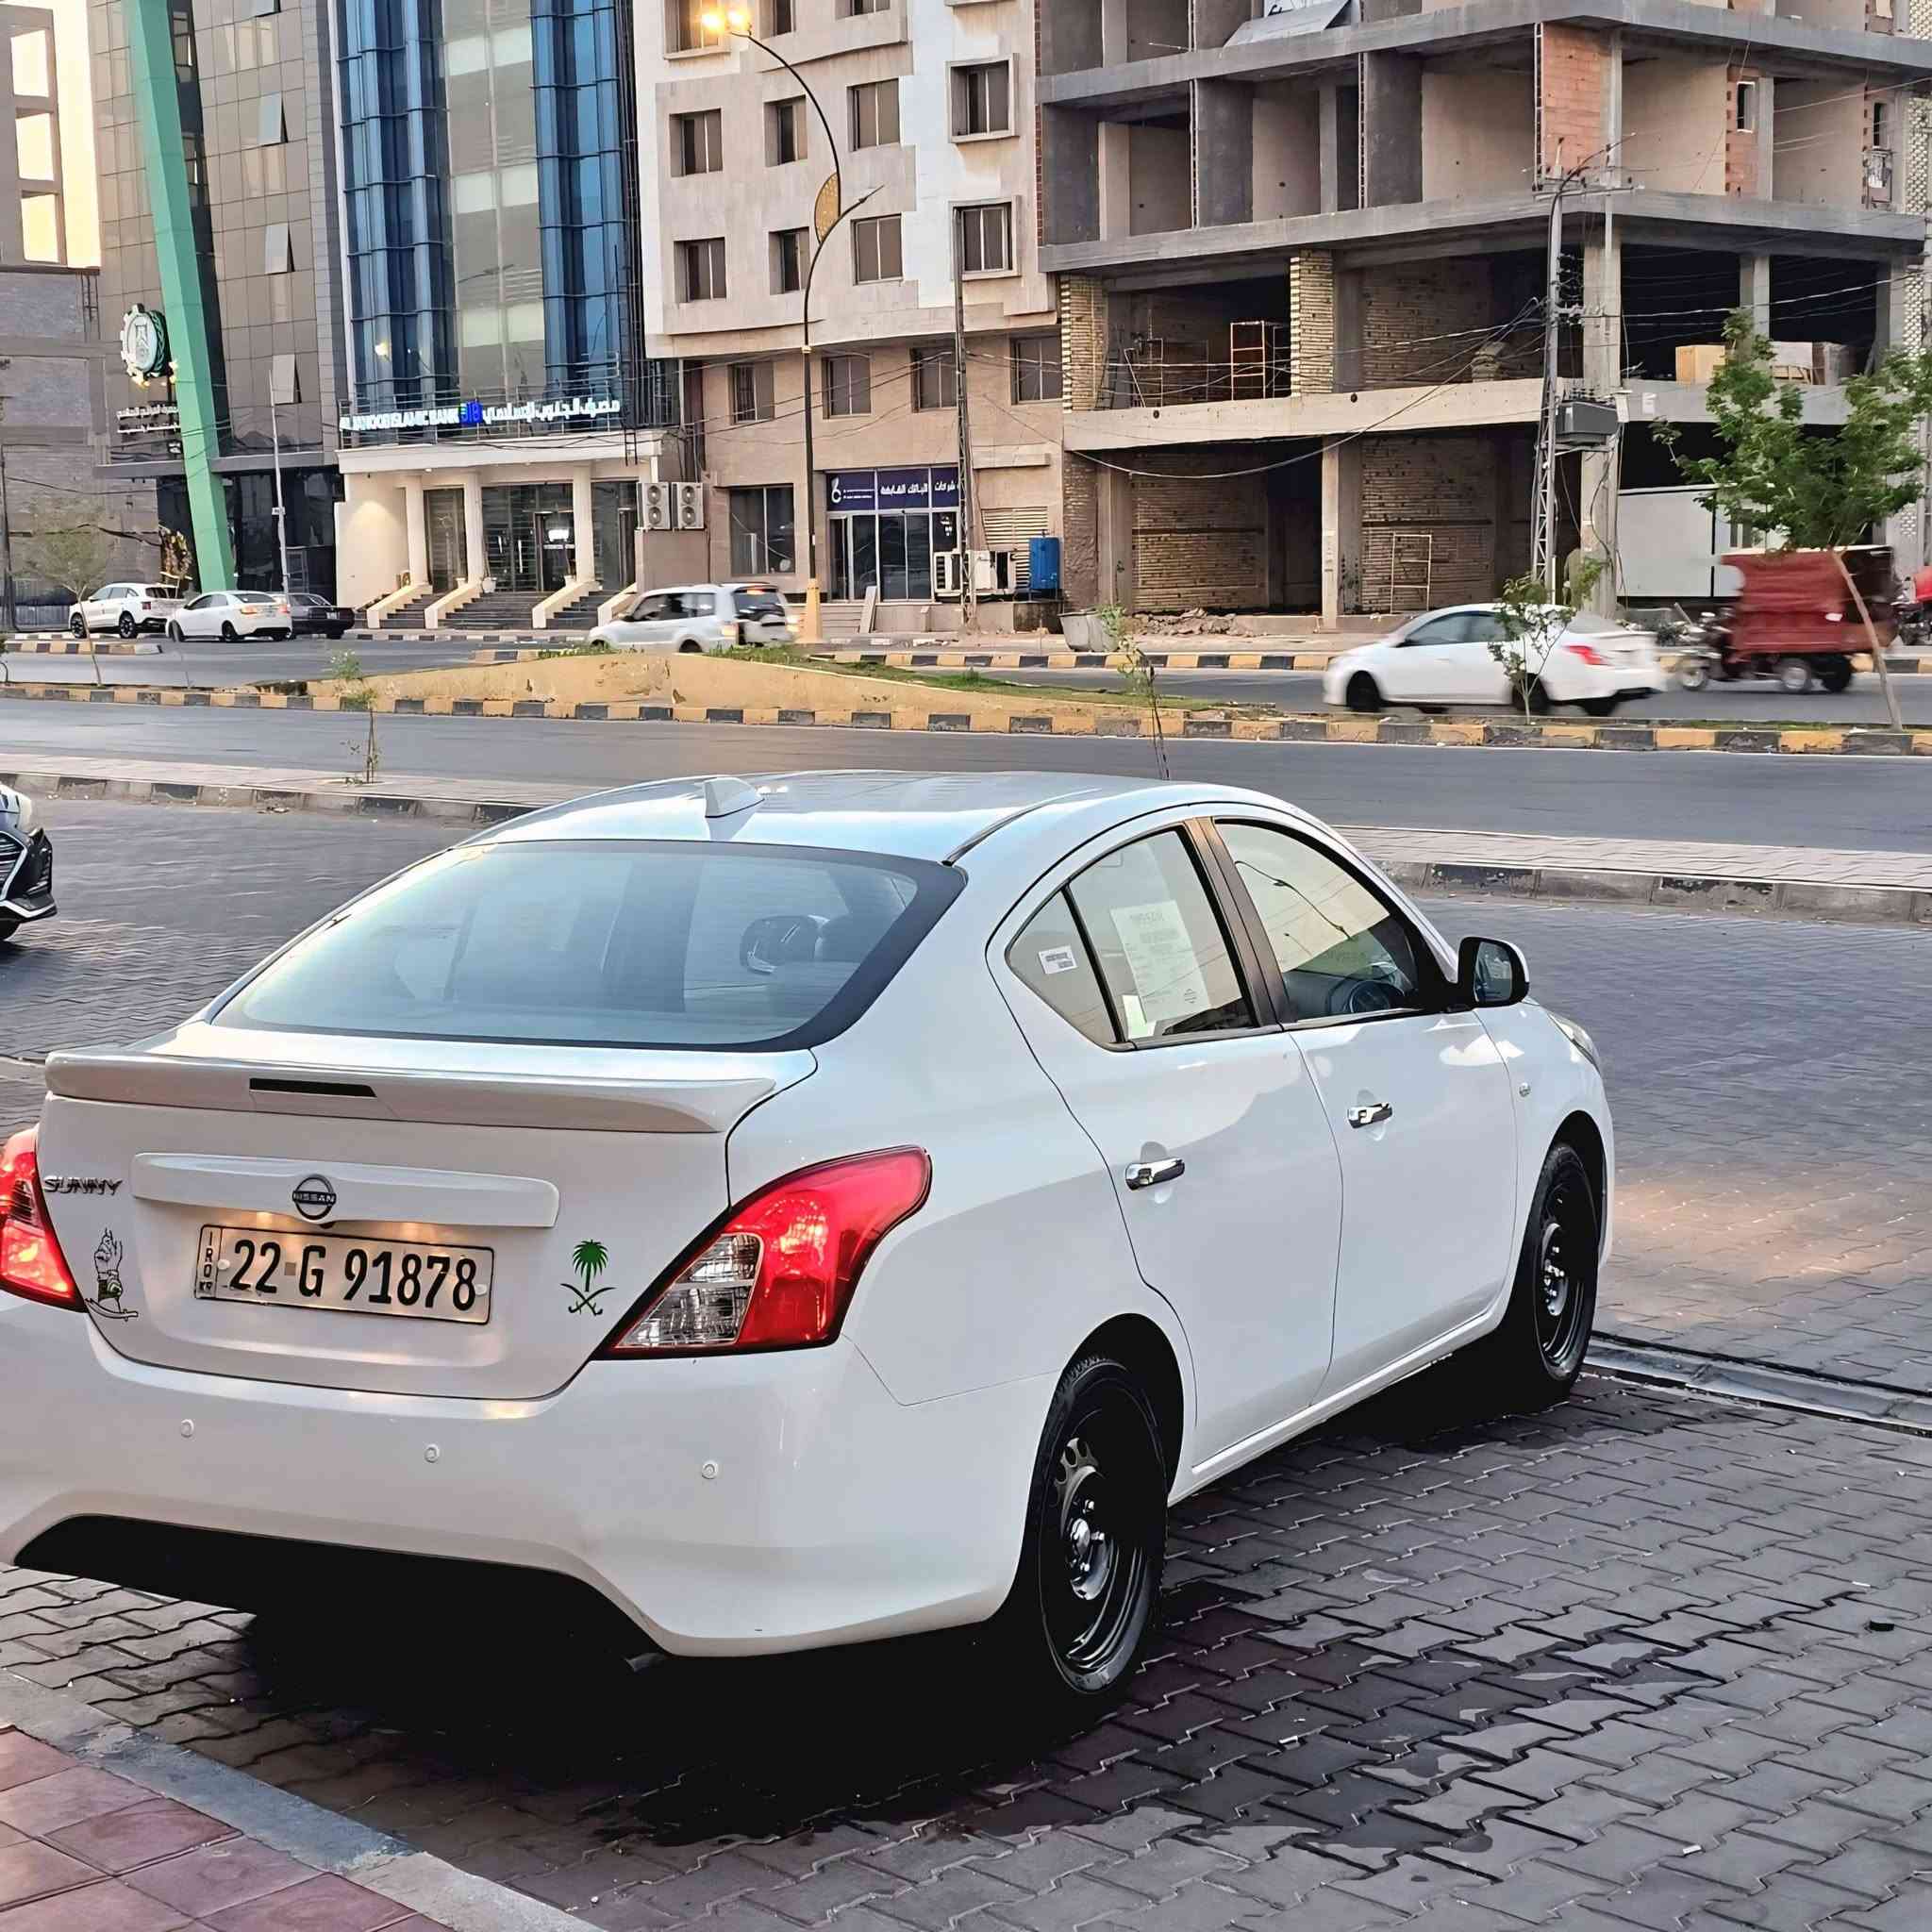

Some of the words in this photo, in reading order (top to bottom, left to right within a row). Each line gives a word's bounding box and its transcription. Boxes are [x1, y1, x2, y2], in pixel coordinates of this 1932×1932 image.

[536, 397, 580, 422] الجنوب
[580, 397, 621, 418] مصرف
[42, 1175, 123, 1196] SUNNY
[293, 1191, 336, 1203] NISSAN
[228, 1239, 281, 1293] 22
[298, 1244, 326, 1297] G
[342, 1248, 477, 1311] 91878
